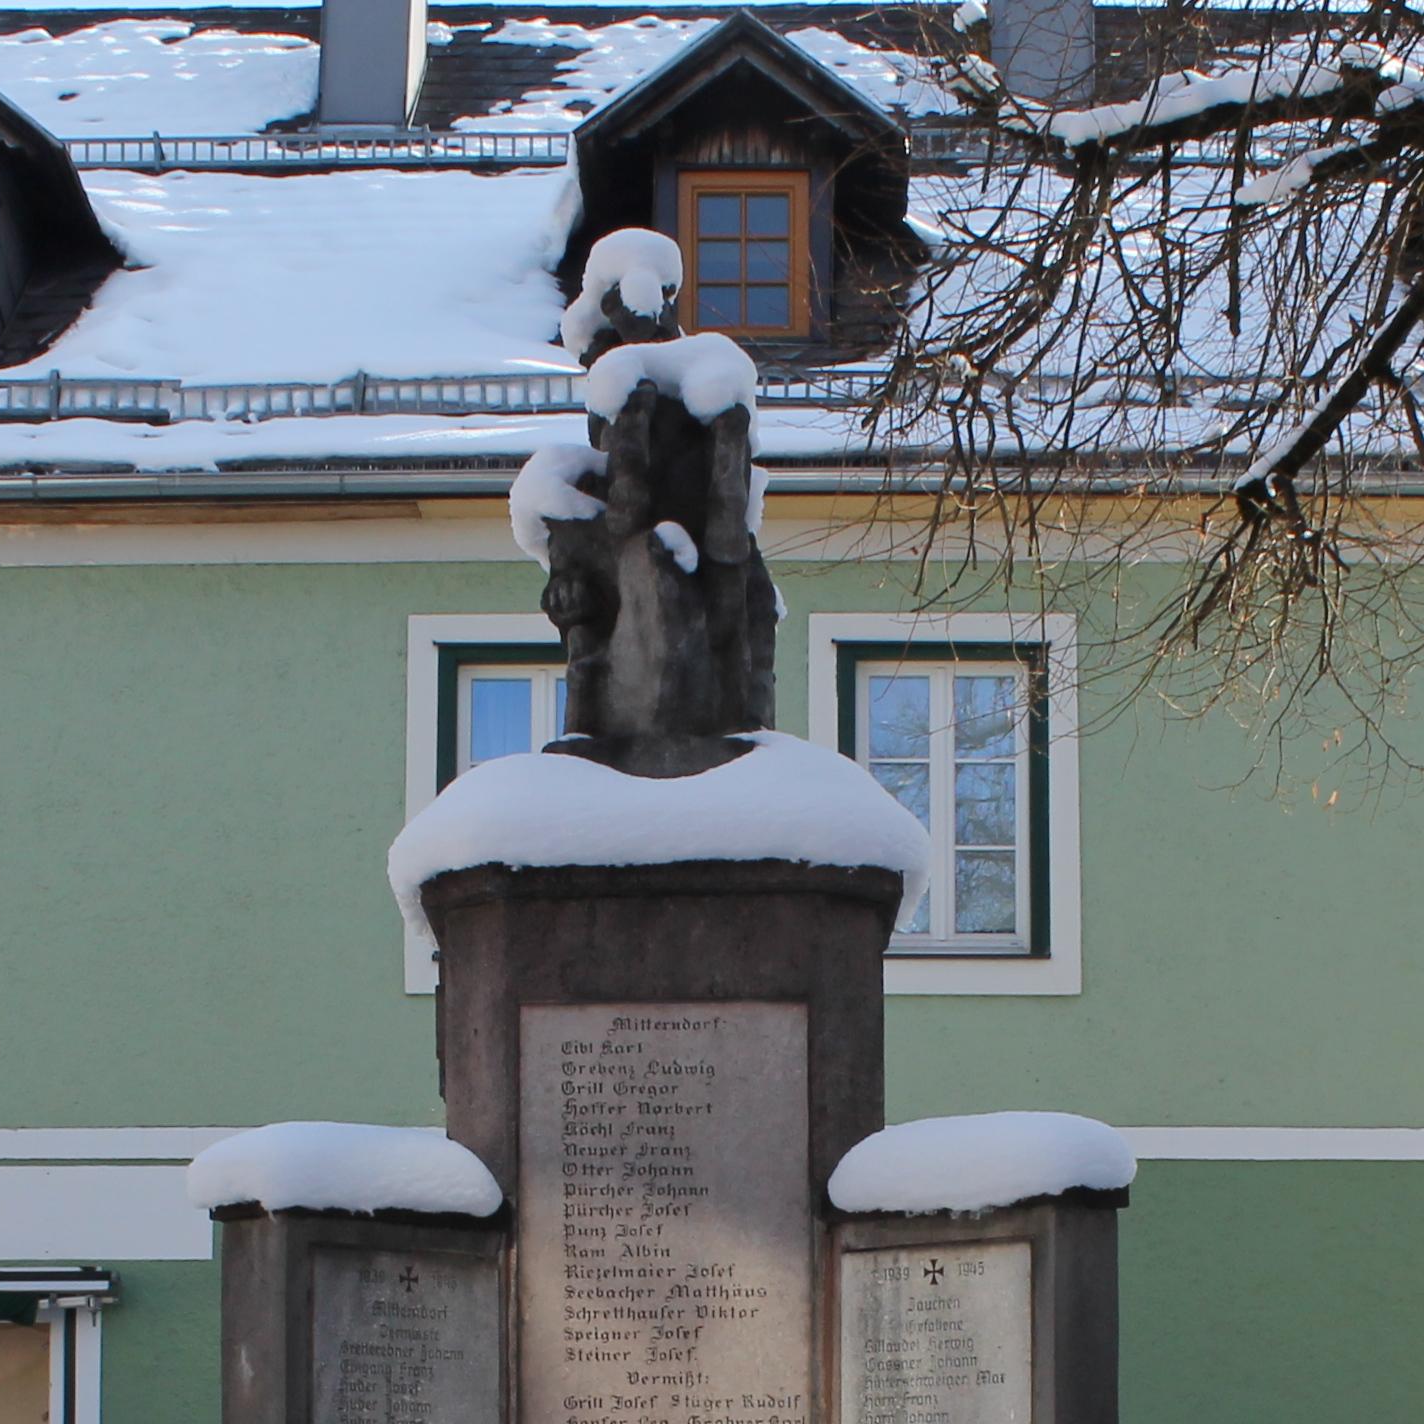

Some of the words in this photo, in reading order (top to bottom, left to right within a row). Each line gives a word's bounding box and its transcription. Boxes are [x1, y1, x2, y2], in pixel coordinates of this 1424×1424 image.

[600, 1040, 643, 1056] Karl
[644, 1060, 716, 1077] Ludwig
[561, 1081, 604, 1096] Grill
[613, 1081, 679, 1099] Gregor
[637, 1102, 713, 1115] Norbert
[562, 1122, 613, 1140] Köchl
[621, 1123, 675, 1140] Franz
[562, 1143, 629, 1159] Neuper
[636, 1143, 691, 1161] Franz
[562, 1163, 614, 1177] Otter
[622, 1163, 694, 1182] Johann
[563, 1183, 634, 1200] Pürcher
[641, 1183, 709, 1201] Johann
[563, 1203, 633, 1220] Pürcher
[641, 1202, 692, 1221] Josef
[564, 1224, 607, 1240] Punz
[615, 1223, 664, 1238] Josef
[620, 1244, 671, 1259] Albin
[685, 1264, 735, 1280] Josef
[883, 1268, 910, 1281] 1939
[958, 1262, 985, 1277] 1945
[564, 1285, 655, 1300] Seebacher
[665, 1284, 768, 1303] Matthäus
[371, 1301, 448, 1319] Mitterndorf
[695, 1305, 760, 1319] Viktor
[651, 1325, 705, 1342] Josef
[420, 1344, 464, 1362] Johann
[927, 1338, 975, 1352] Herwig
[564, 1347, 631, 1362] Steiner
[400, 1362, 435, 1380] Franz
[929, 1355, 977, 1373] Johann
[976, 1371, 1006, 1386] Max
[386, 1394, 432, 1415] Johann
[564, 1395, 603, 1410] Grill
[611, 1395, 658, 1411] Josef
[742, 1394, 802, 1410] Rudolf
[903, 1391, 938, 1409] Franz
